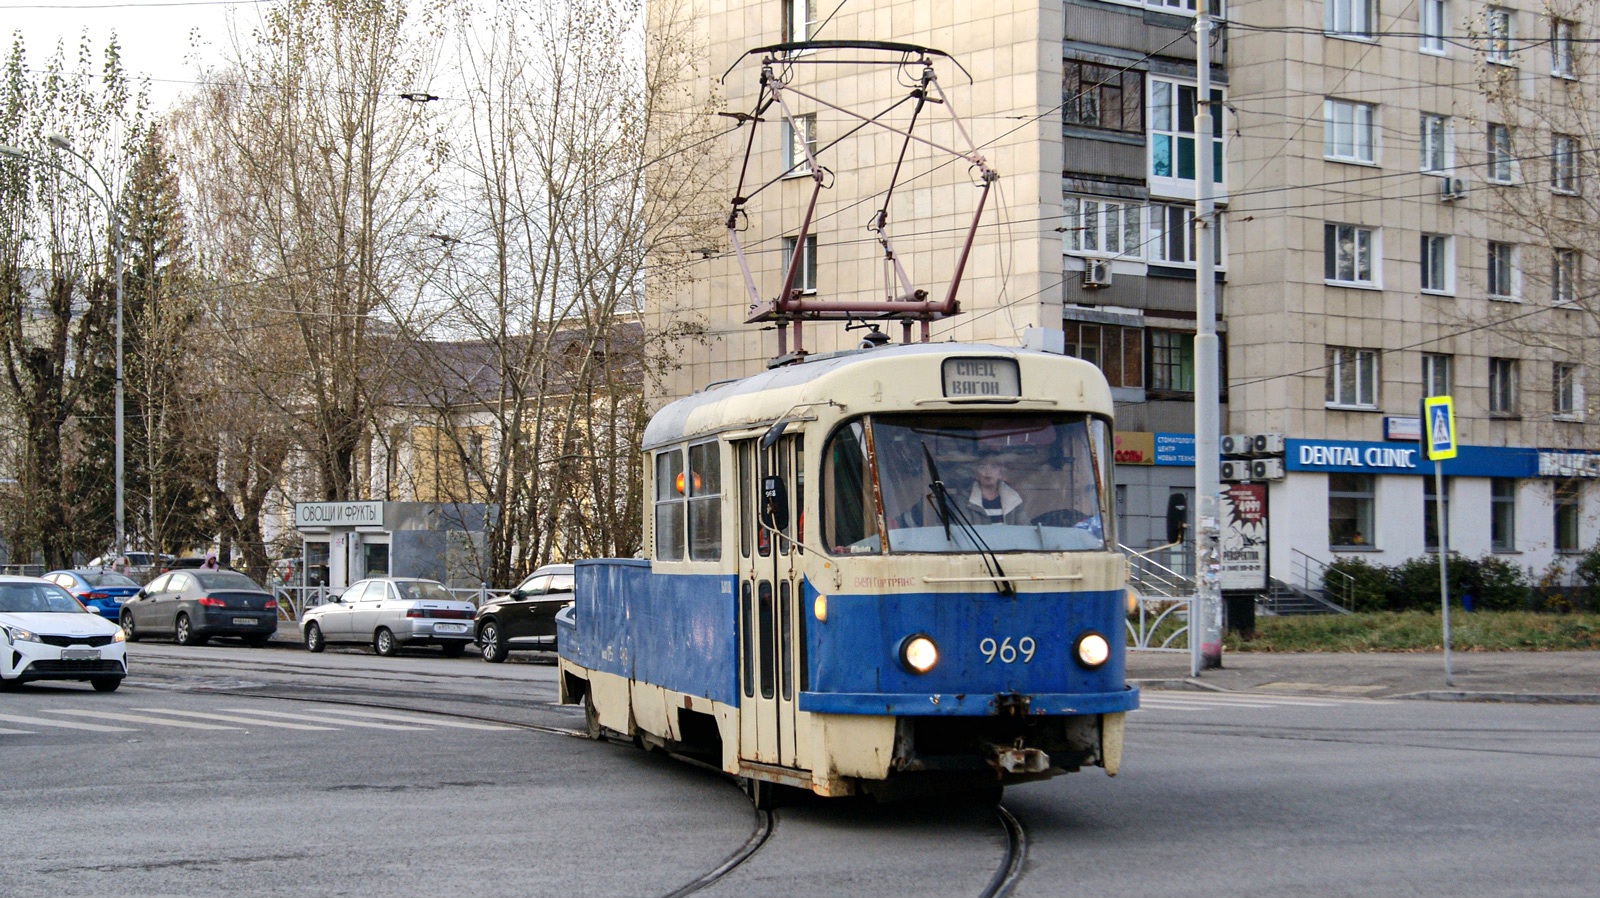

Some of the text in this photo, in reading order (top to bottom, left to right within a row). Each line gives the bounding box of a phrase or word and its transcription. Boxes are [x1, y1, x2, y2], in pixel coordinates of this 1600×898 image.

[957, 361, 996, 378] СПЕЦ
[952, 381, 999, 395] ВАГОН
[1157, 445, 1176, 453] ЦЕНТР
[1300, 445, 1417, 468] DENTAL CLINIC
[302, 504, 377, 522] ОВОЩИ И ФРУКТЫ
[979, 636, 1036, 664] 969
